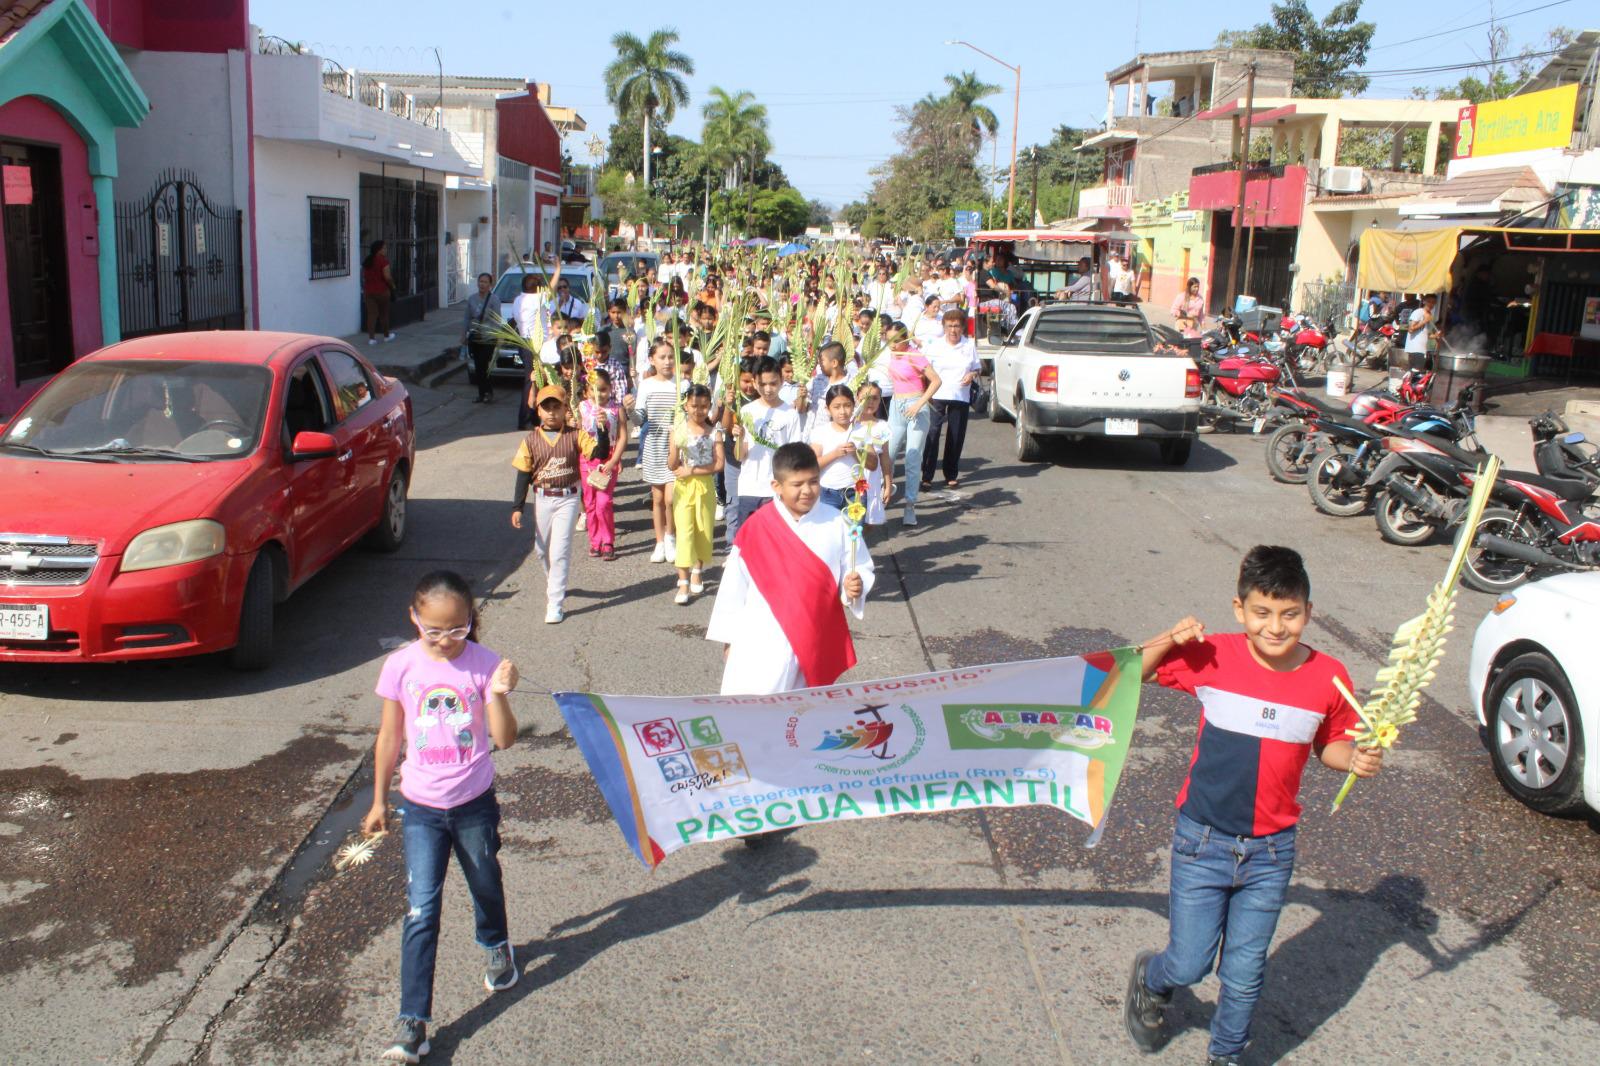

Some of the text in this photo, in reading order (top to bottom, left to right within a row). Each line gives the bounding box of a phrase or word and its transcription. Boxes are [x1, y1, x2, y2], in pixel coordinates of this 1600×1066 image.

[1535, 110, 1560, 134] Ana
[984, 710, 1113, 735] ABRAZAR
[1262, 707, 1276, 720] 88
[786, 716, 799, 748] JUBILEO
[699, 800, 725, 812] La
[728, 783, 833, 806] Esperanza
[838, 778, 864, 790] no
[868, 769, 960, 788] defrauda
[966, 766, 1007, 780] (Rm
[675, 778, 1085, 844] PASCUA INFANTIL
